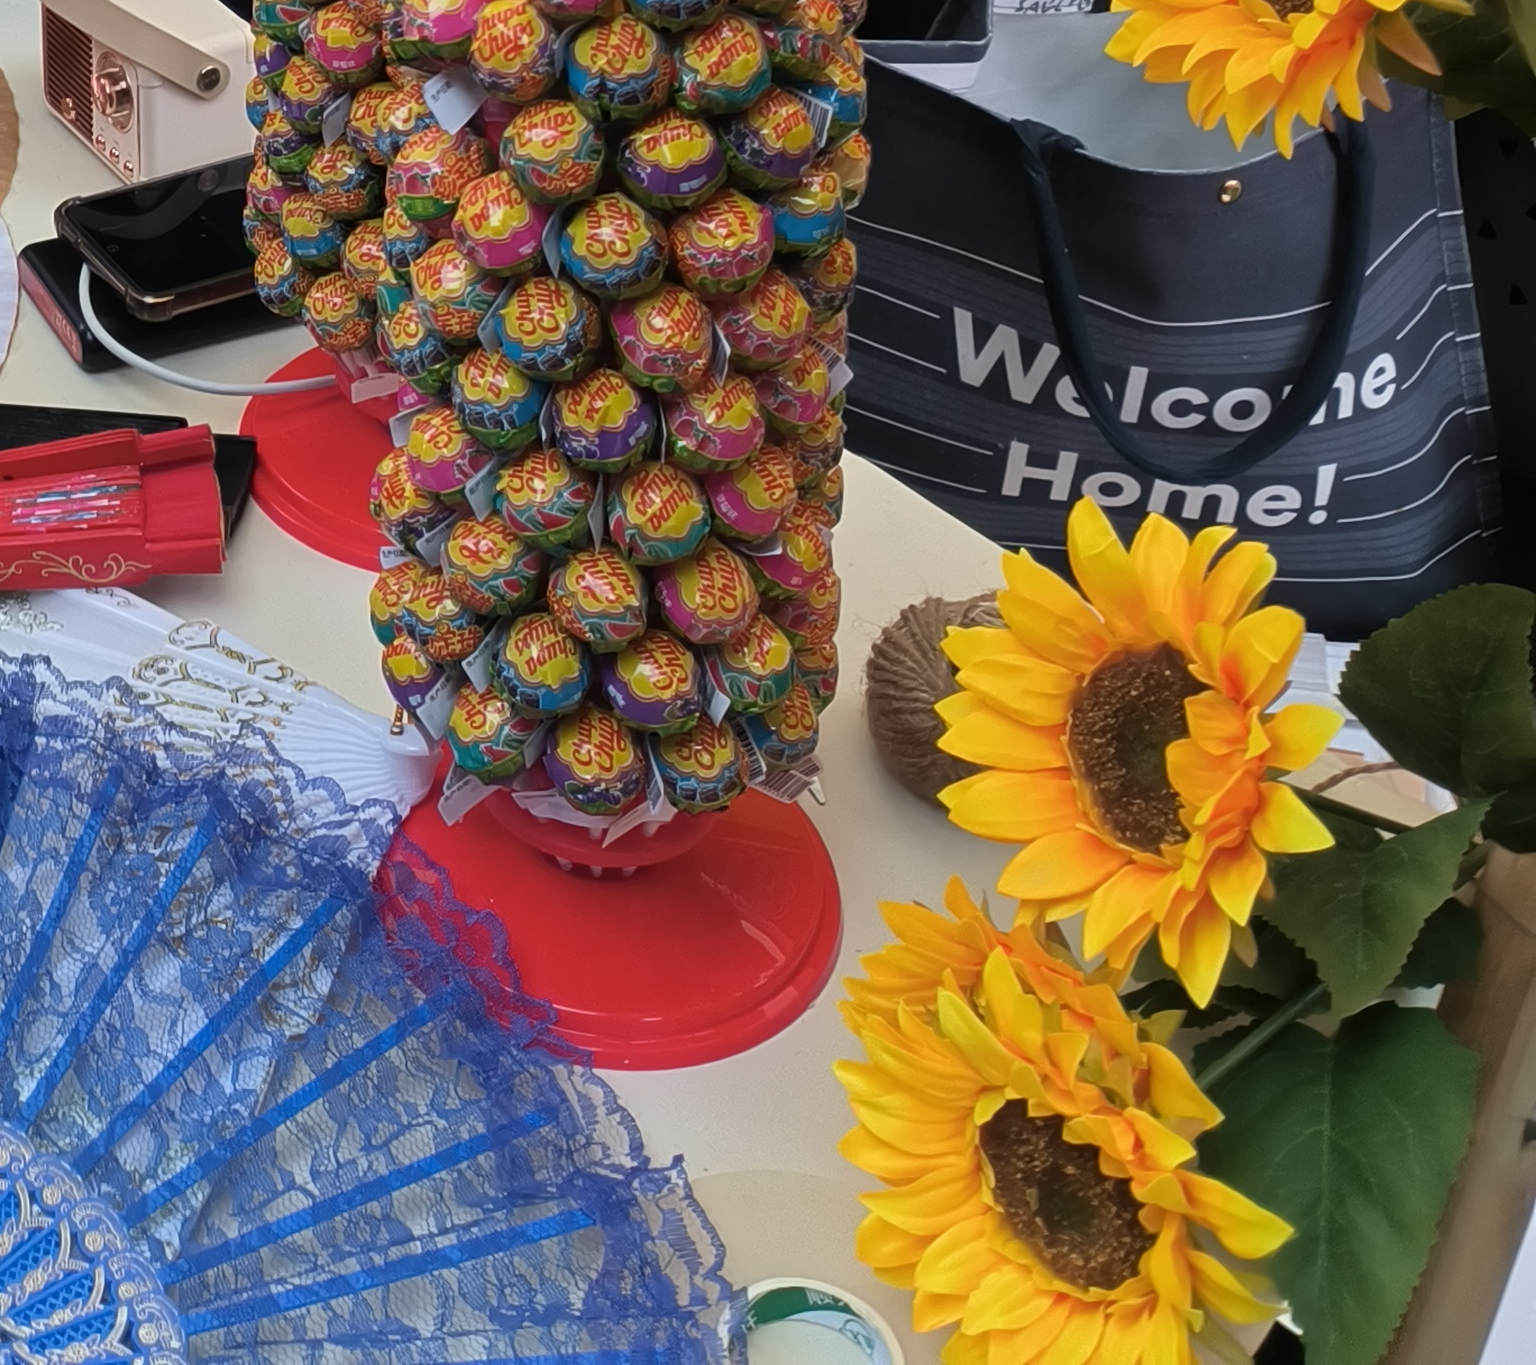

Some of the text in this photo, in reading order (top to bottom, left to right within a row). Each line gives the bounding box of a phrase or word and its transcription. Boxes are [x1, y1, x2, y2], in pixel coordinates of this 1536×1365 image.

[706, 32, 758, 80] Chupa
[517, 286, 538, 337] Chup
[646, 478, 694, 533] Chupa
[1001, 440, 1339, 528] Home!
[697, 558, 717, 613] Chup
[525, 640, 577, 677] Chupa
[572, 720, 593, 767] Chup
